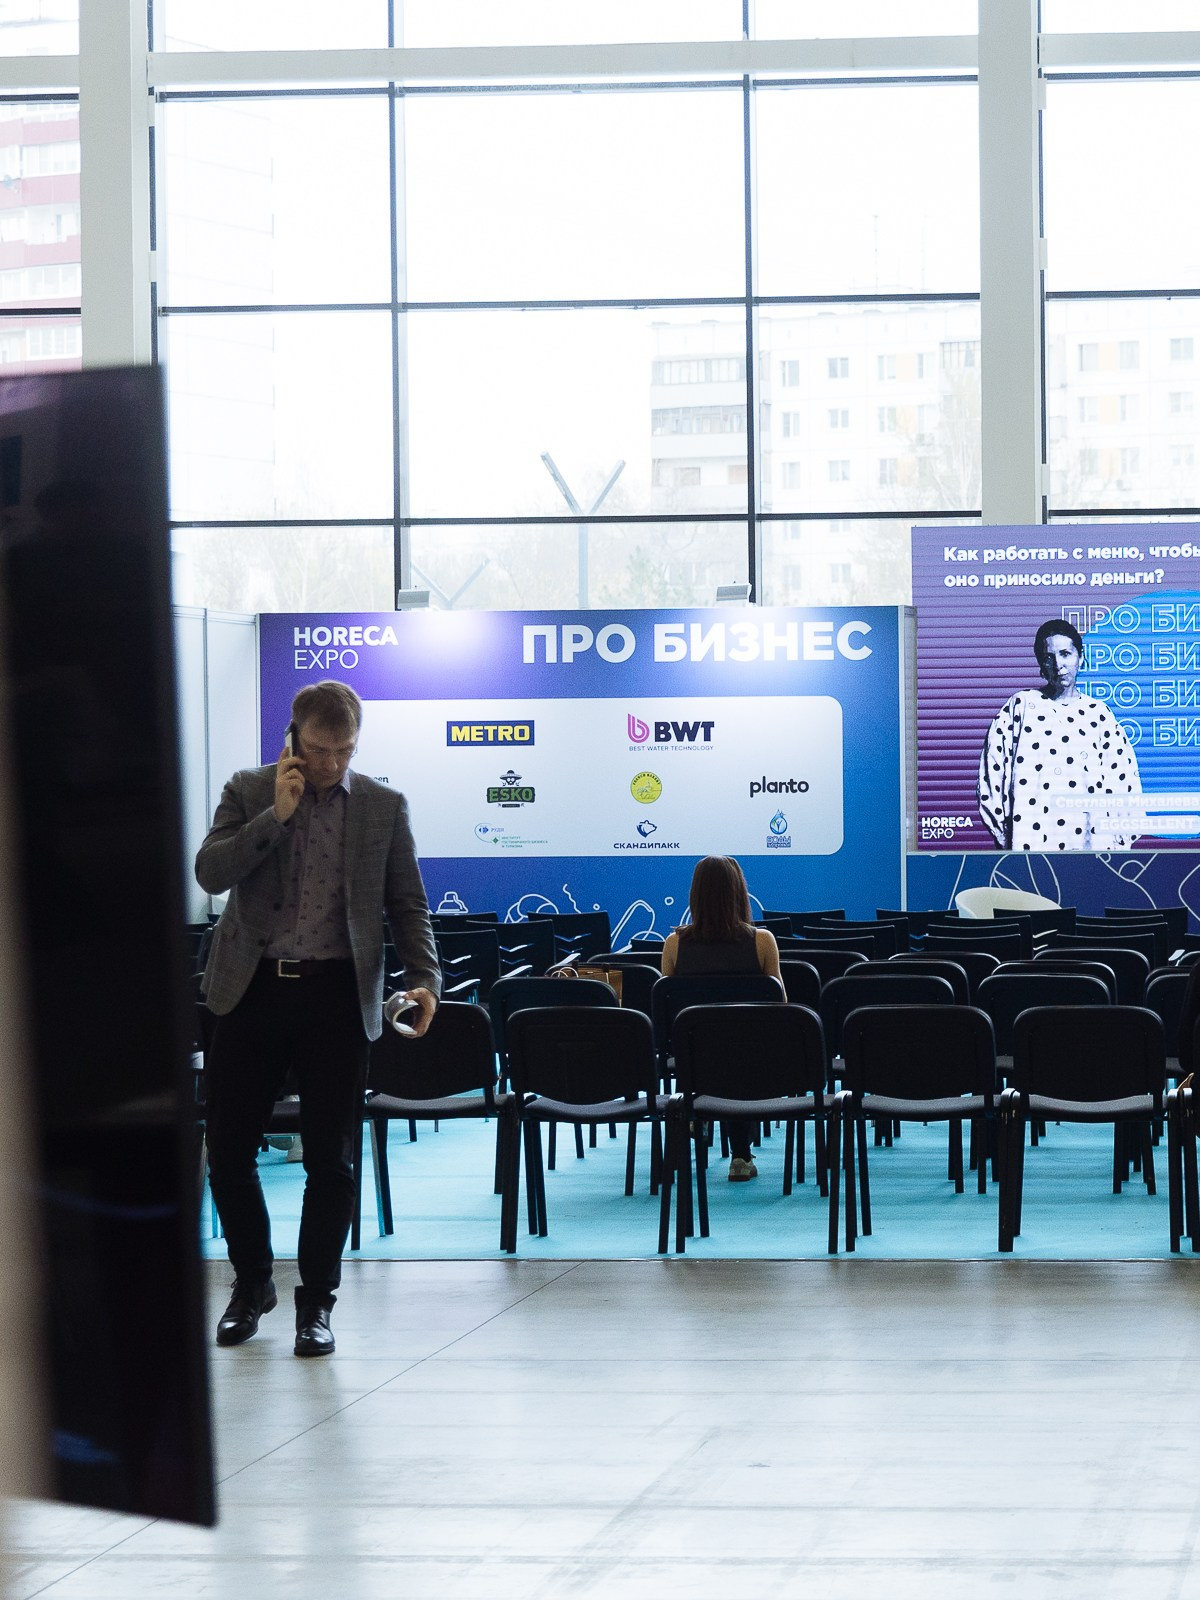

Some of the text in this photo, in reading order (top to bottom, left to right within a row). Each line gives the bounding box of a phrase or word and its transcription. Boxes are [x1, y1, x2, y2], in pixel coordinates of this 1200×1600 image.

[944, 546, 979, 561] Как
[983, 545, 1068, 563] работать
[1073, 549, 1083, 560] с
[1087, 546, 1145, 561] меню,
[944, 568, 1165, 589] оно приносило деньги?
[1061, 604, 1141, 634] ПРО
[294, 625, 399, 647] HORECA
[522, 620, 873, 664] ПРО БИЗНЕС
[294, 649, 359, 670] EXPO
[451, 725, 530, 742] METRO
[654, 721, 715, 742] BWT
[488, 787, 534, 802] ESKO
[750, 776, 809, 798] planto
[1055, 795, 1200, 809] Светлана Михалева
[921, 817, 973, 828] HORECA
[1100, 817, 1196, 831] EGGSELLENT
[922, 828, 954, 839] EXPO
